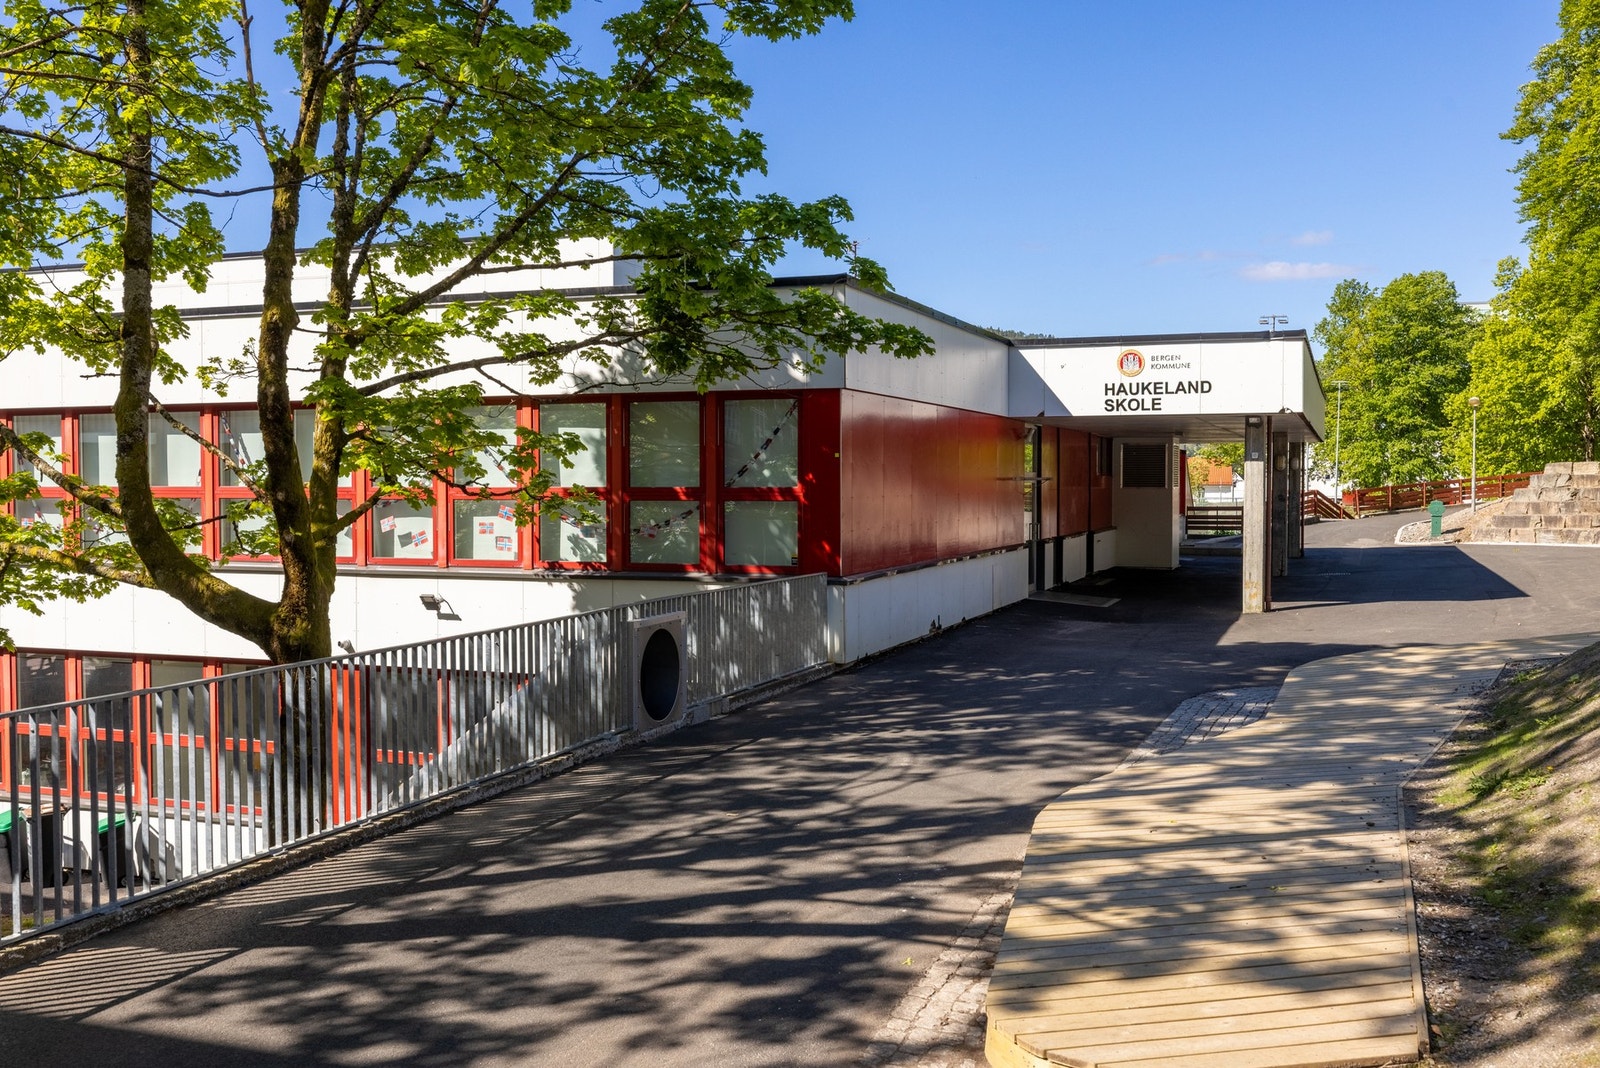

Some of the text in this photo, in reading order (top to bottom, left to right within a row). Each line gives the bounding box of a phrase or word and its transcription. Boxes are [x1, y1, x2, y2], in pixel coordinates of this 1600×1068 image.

[1150, 354, 1181, 362] BERGEN
[1150, 362, 1191, 370] KOMMUNE
[1104, 381, 1212, 396] HAUKELAND
[1104, 398, 1162, 412] SKOLE
